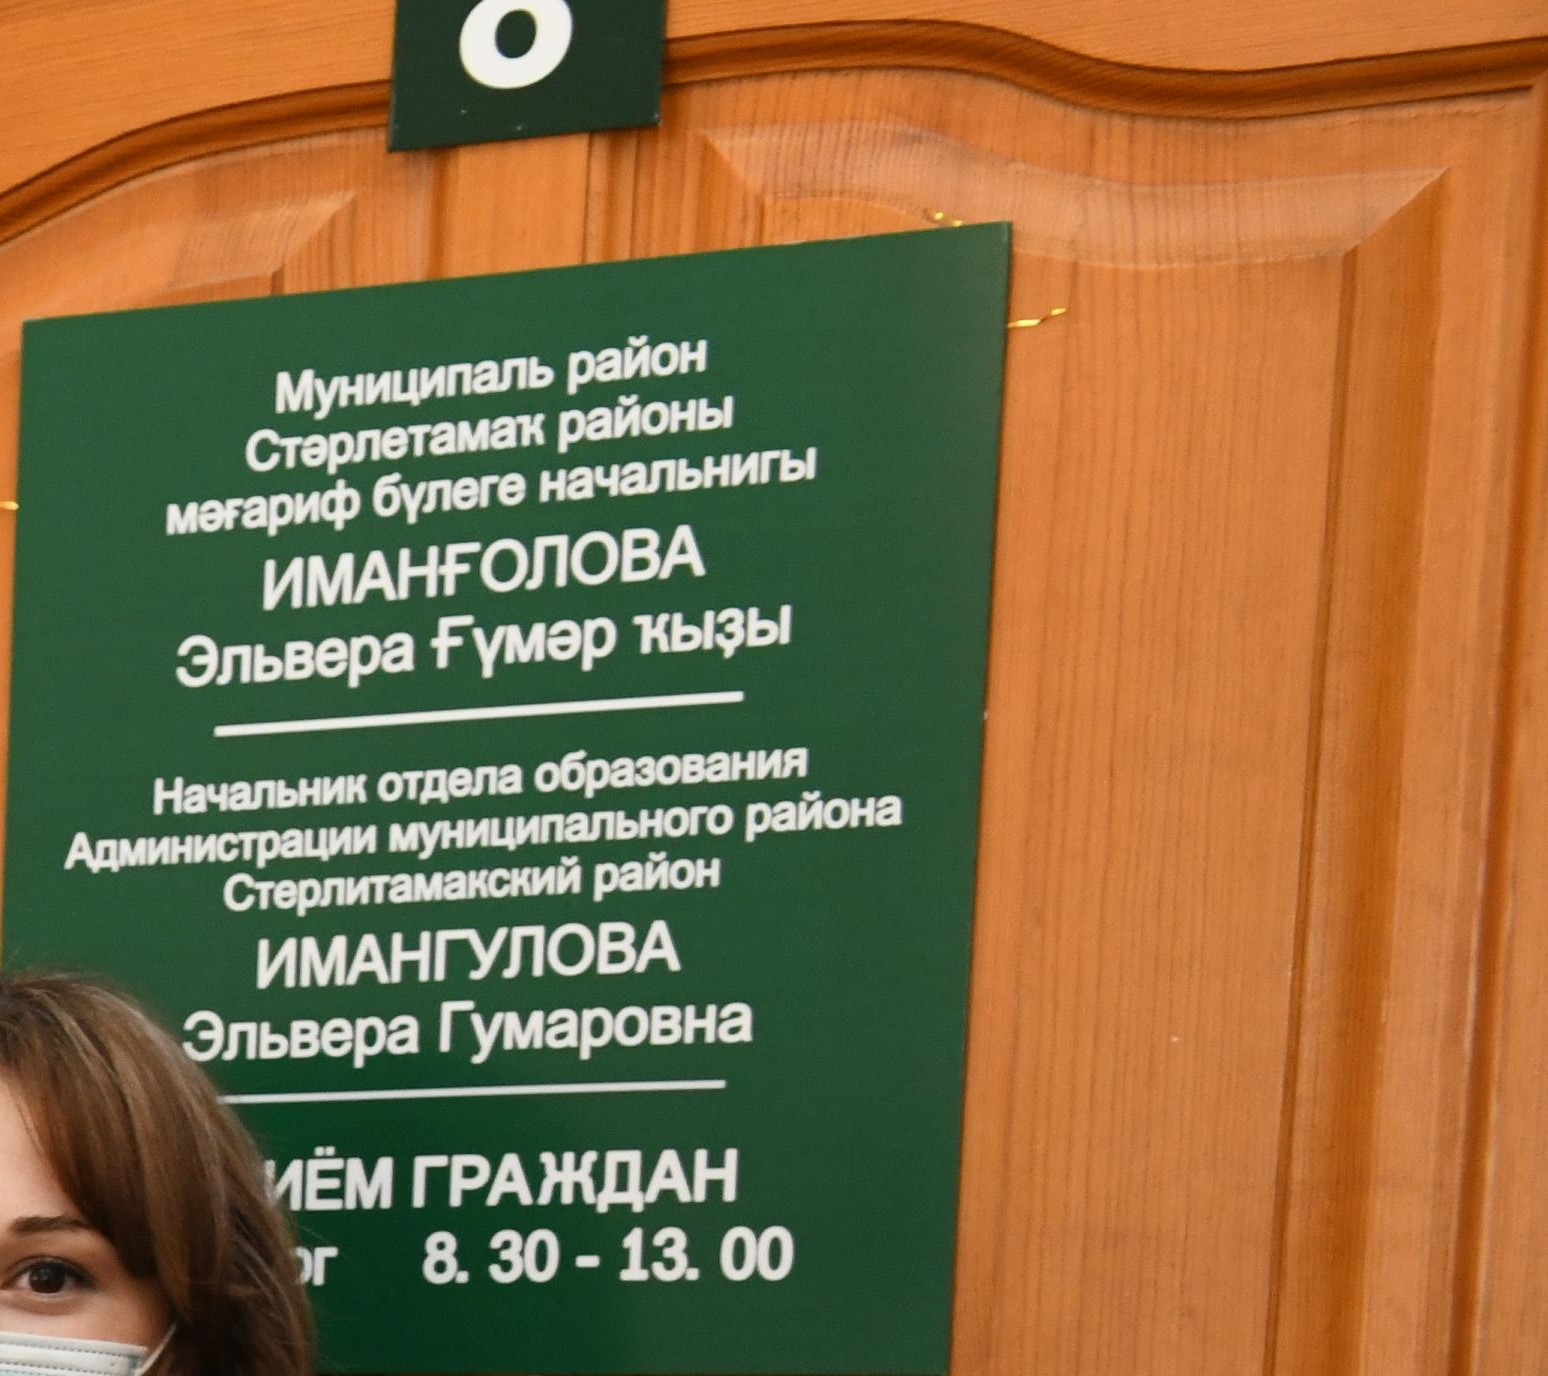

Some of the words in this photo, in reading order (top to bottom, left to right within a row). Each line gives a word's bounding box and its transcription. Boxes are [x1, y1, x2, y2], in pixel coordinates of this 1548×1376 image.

[275, 356, 555, 421] Муниципаль
[566, 335, 708, 395] район
[244, 411, 546, 473] Стәрлетамаҡ
[557, 394, 734, 454] районы
[166, 481, 361, 537] мәғариф
[372, 472, 527, 525] бүлеге
[539, 446, 817, 503] начальнигы
[262, 524, 706, 611] ИМАНҒОЛОВА
[175, 632, 415, 689] Эльвера
[430, 614, 618, 679] Ғүмәр
[632, 604, 792, 659] ҡыҙы
[153, 773, 368, 816] Начальник
[377, 763, 523, 805] отдела
[534, 747, 808, 799] образования
[63, 824, 378, 874] Администрации
[388, 804, 735, 860] муниципального
[745, 790, 903, 843] района
[223, 855, 582, 918] Стерлитамакский
[593, 851, 721, 903] район
[256, 919, 682, 990] ИМАНГУЛОВА
[182, 1010, 420, 1069] Эльвера
[439, 1000, 753, 1065] Гумаровна
[263, 1146, 394, 1211] ИЁМ
[412, 1147, 738, 1214] ГРАЖДАН
[488, 1228, 560, 1284] 30
[575, 1255, 600, 1268] -
[619, 1226, 700, 1282] 13.
[720, 1225, 795, 1282] 00
